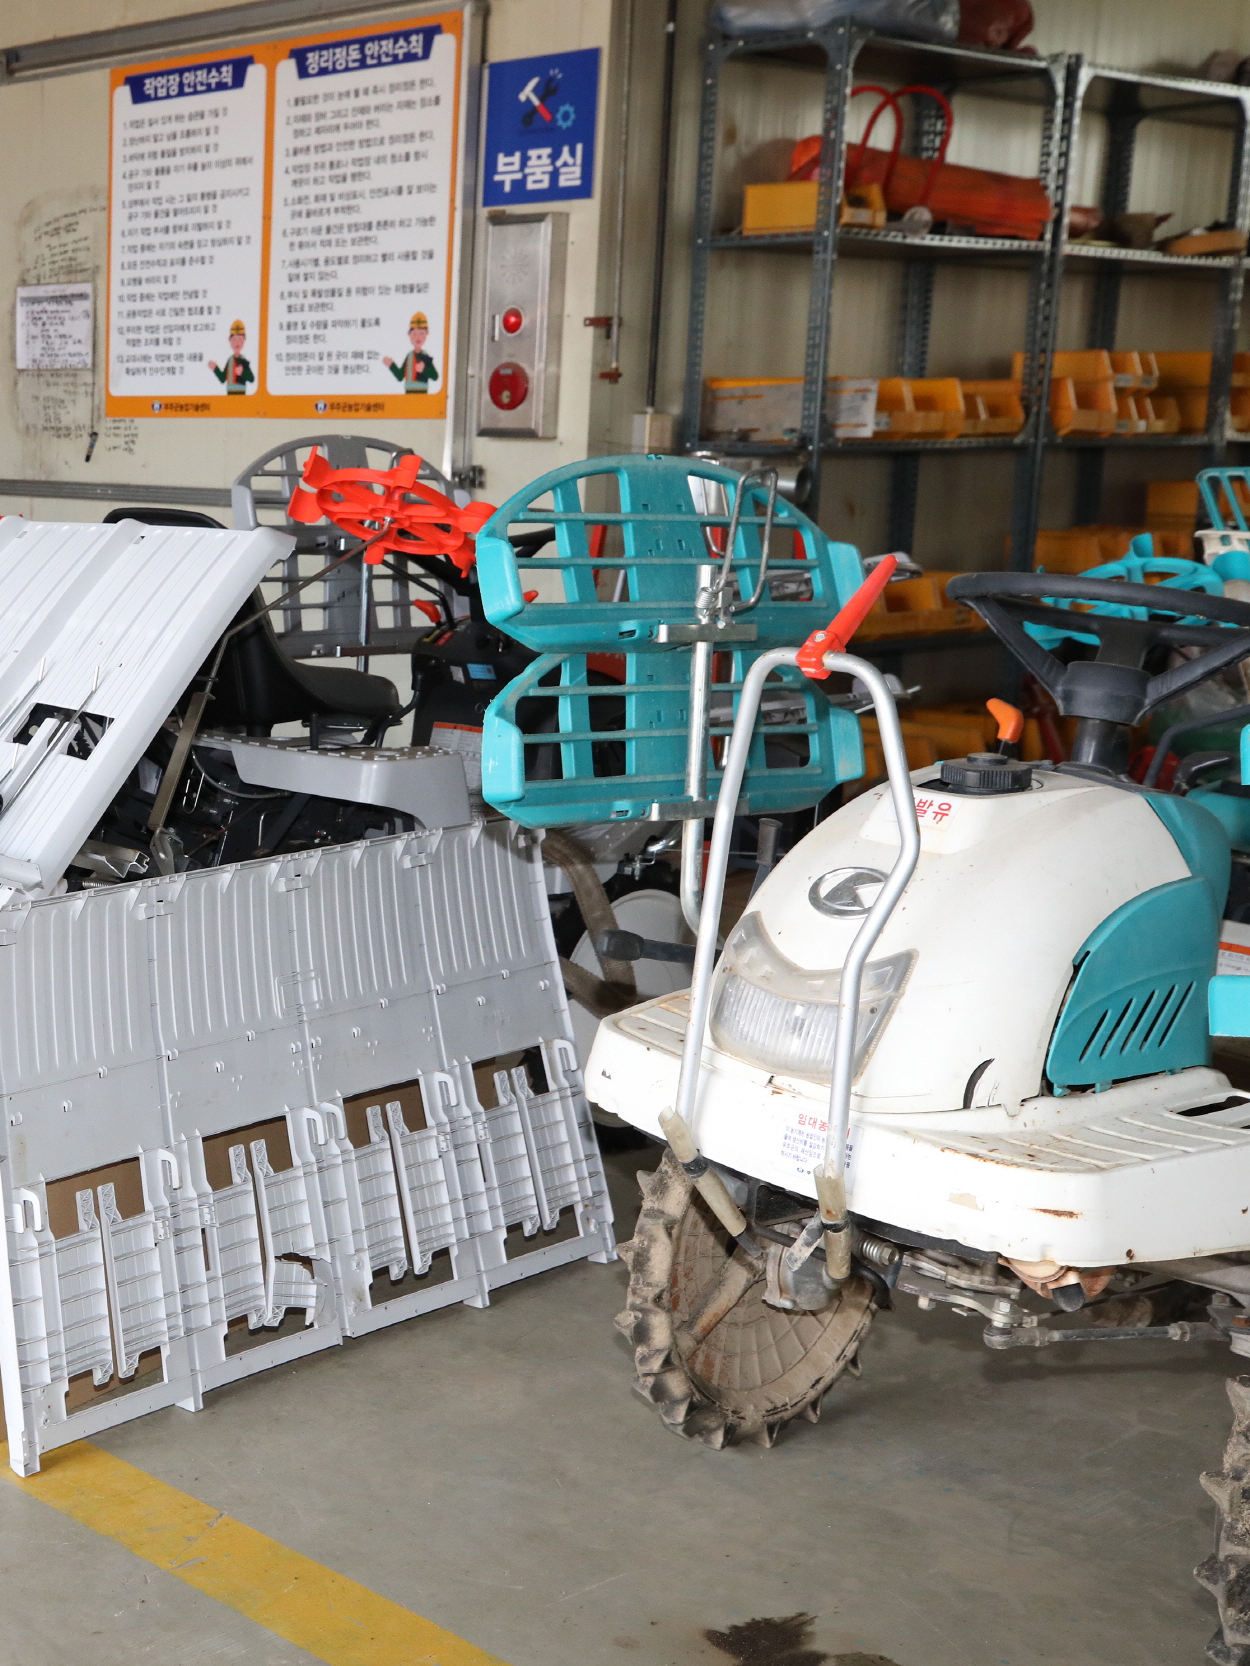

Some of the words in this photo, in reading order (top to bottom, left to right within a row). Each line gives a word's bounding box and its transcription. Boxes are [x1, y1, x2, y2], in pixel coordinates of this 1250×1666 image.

[305, 44, 361, 73] 정리정돈
[364, 34, 423, 63] 안전수칙
[143, 73, 179, 98] 작업장
[182, 65, 232, 91] 안전수칙
[493, 142, 584, 193] 부품실
[913, 797, 952, 822] 발유
